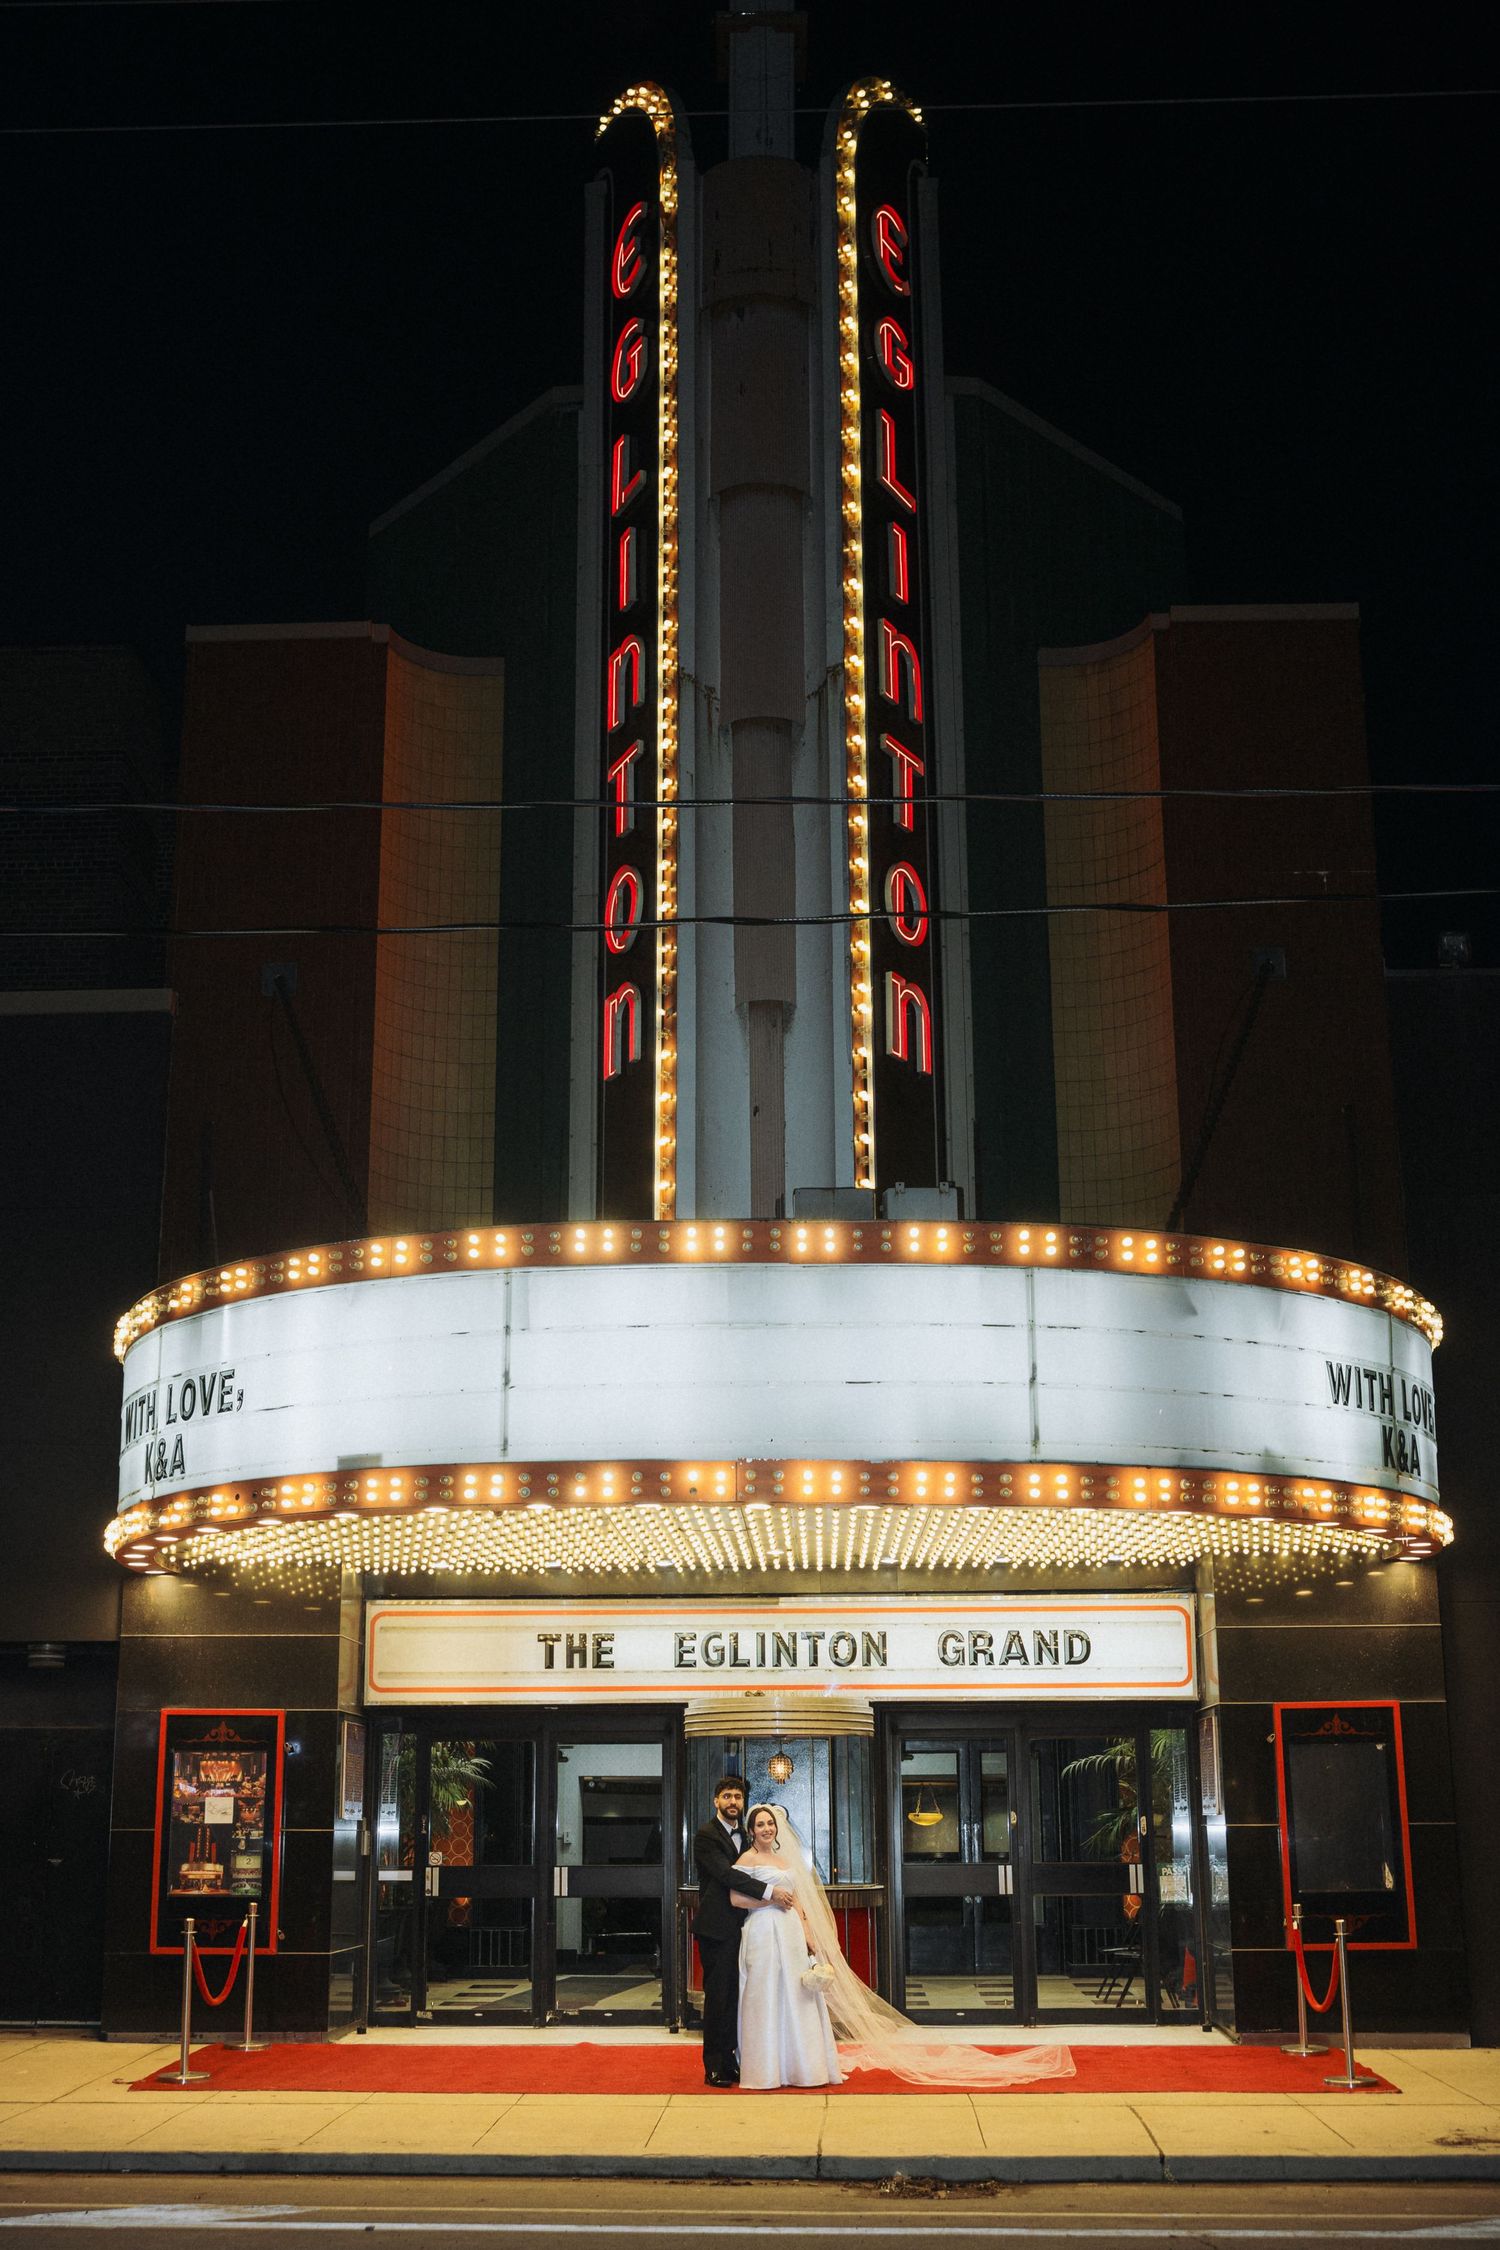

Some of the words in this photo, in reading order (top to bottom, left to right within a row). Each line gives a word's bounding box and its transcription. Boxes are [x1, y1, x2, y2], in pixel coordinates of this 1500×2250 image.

[125, 1390, 158, 1445] WITH
[166, 1369, 244, 1425] LOVE,
[1326, 1361, 1393, 1416] WITH
[144, 1433, 186, 1485] K&A
[1382, 1424, 1421, 1477] K&A
[537, 1632, 615, 1669] THE
[674, 1631, 888, 1668] EGLINTON
[937, 1629, 1092, 1666] GRAND
